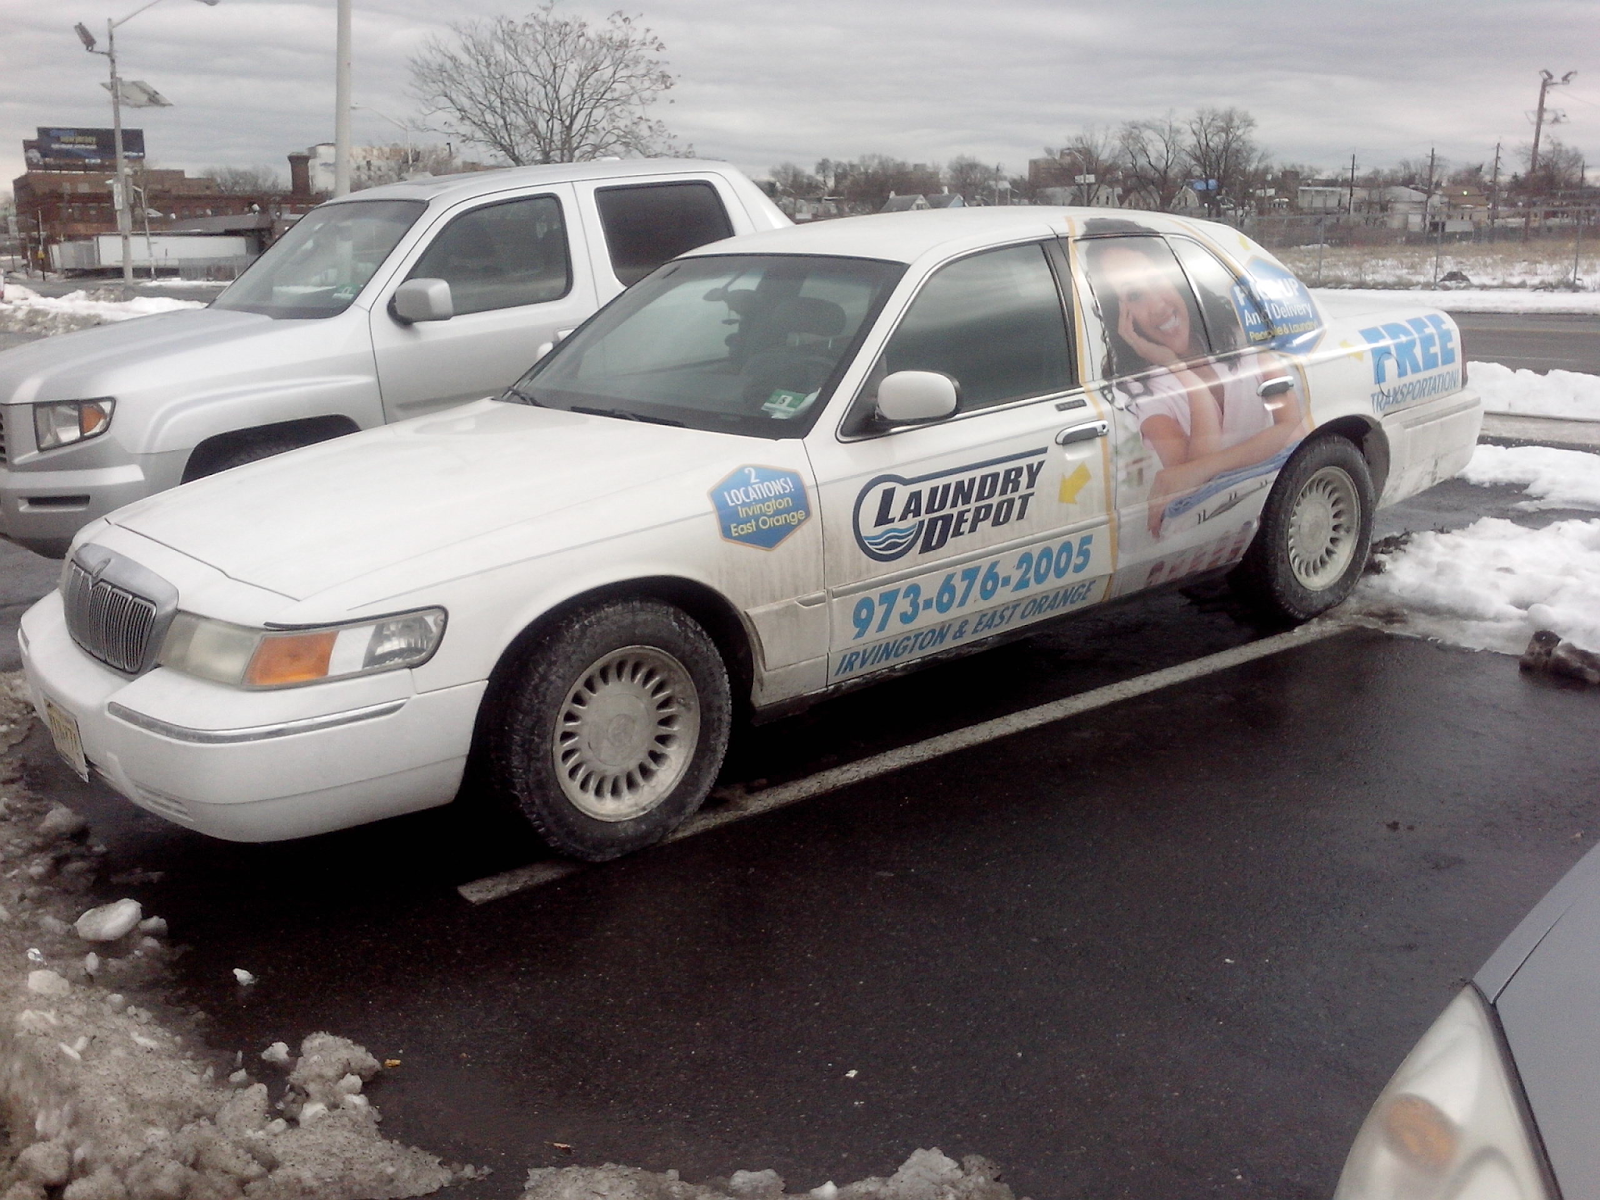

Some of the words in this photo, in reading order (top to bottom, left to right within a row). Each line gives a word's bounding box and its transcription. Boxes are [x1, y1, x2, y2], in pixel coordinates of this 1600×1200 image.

[1271, 299, 1313, 319] Delivery
[1358, 313, 1455, 385] FREE
[1370, 369, 1460, 414] TRANSPORTATION!
[723, 477, 794, 507] LOCATIONS!
[744, 467, 760, 483] 2
[873, 460, 1045, 527] LAUNDRY
[730, 521, 757, 537] East
[759, 508, 806, 530] Orange
[738, 496, 792, 518] Irvington
[918, 491, 1035, 555] DEPOT
[852, 534, 1094, 640] 973-676-2005
[834, 622, 951, 677] IRVINGTON
[952, 619, 969, 641] &
[972, 603, 1020, 635] EAST
[1020, 579, 1097, 621] ORANGE
